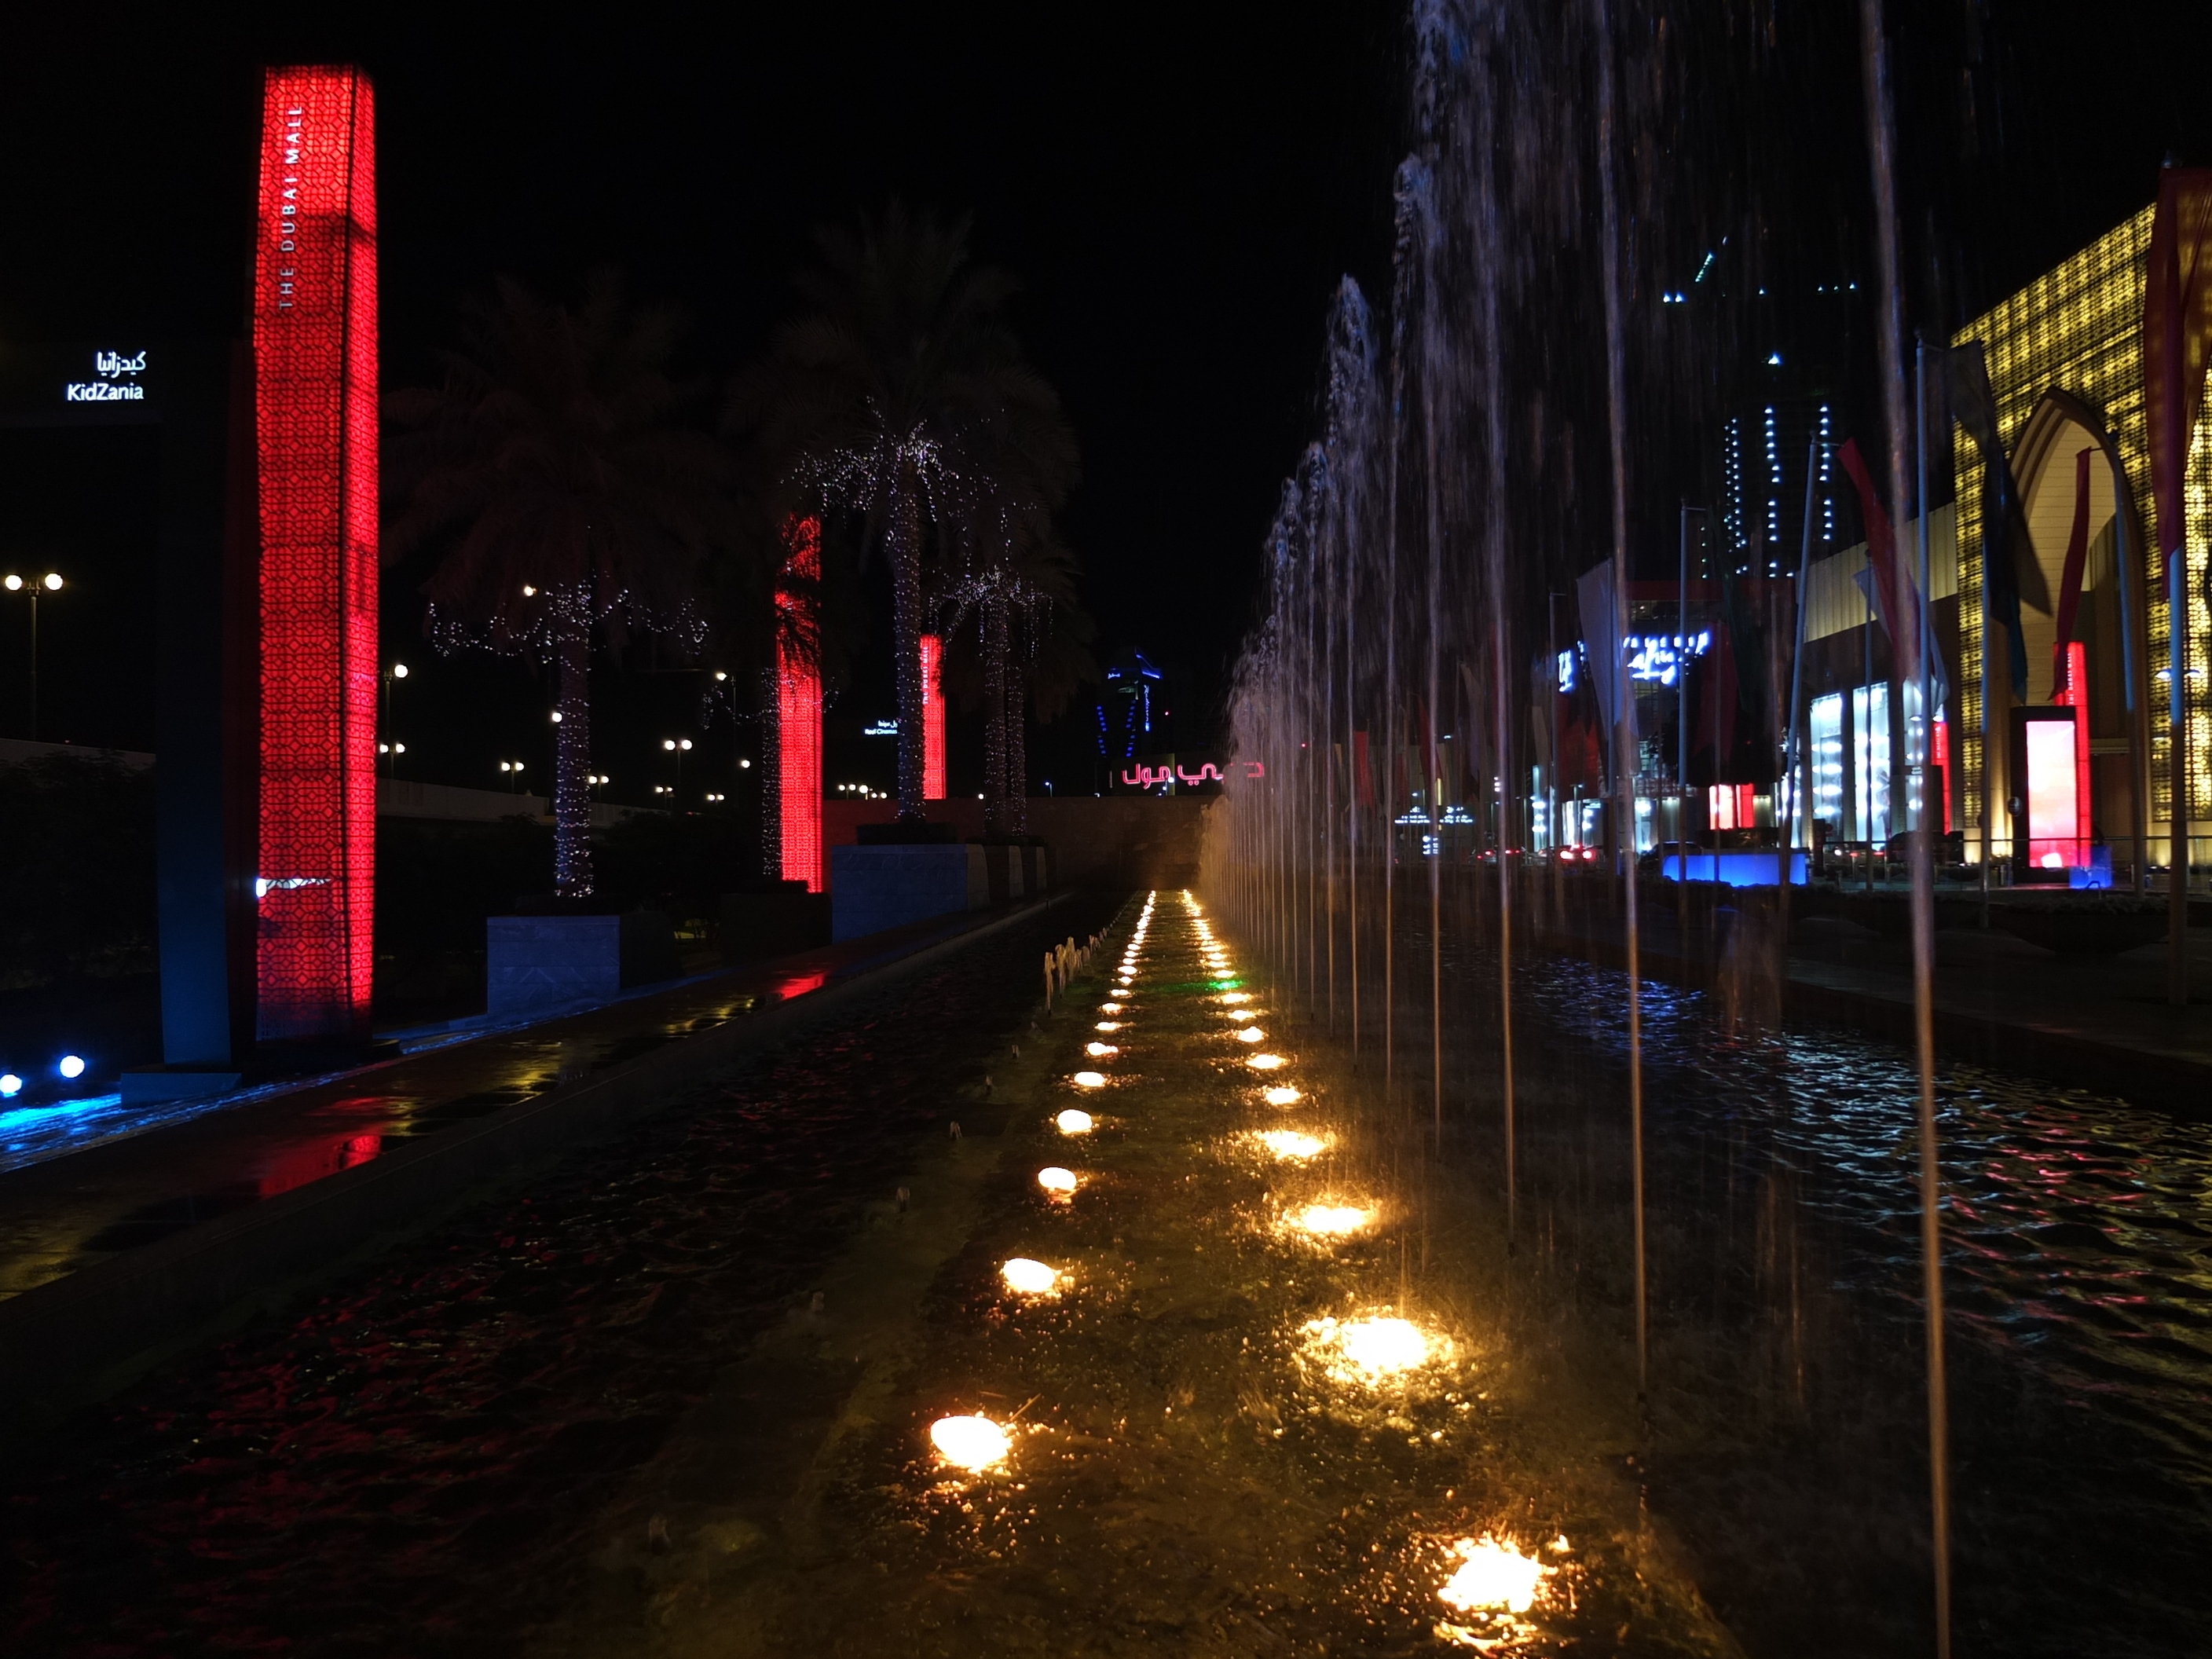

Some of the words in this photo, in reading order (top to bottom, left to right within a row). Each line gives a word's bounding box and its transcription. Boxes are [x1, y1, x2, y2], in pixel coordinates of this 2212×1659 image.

[284, 106, 302, 165] MALL
[280, 177, 298, 251] DUBAI
[278, 267, 295, 310] THE
[97, 350, 146, 379] كيدزانيا
[67, 382, 145, 401] KidZania
[1122, 763, 1170, 789] مول
